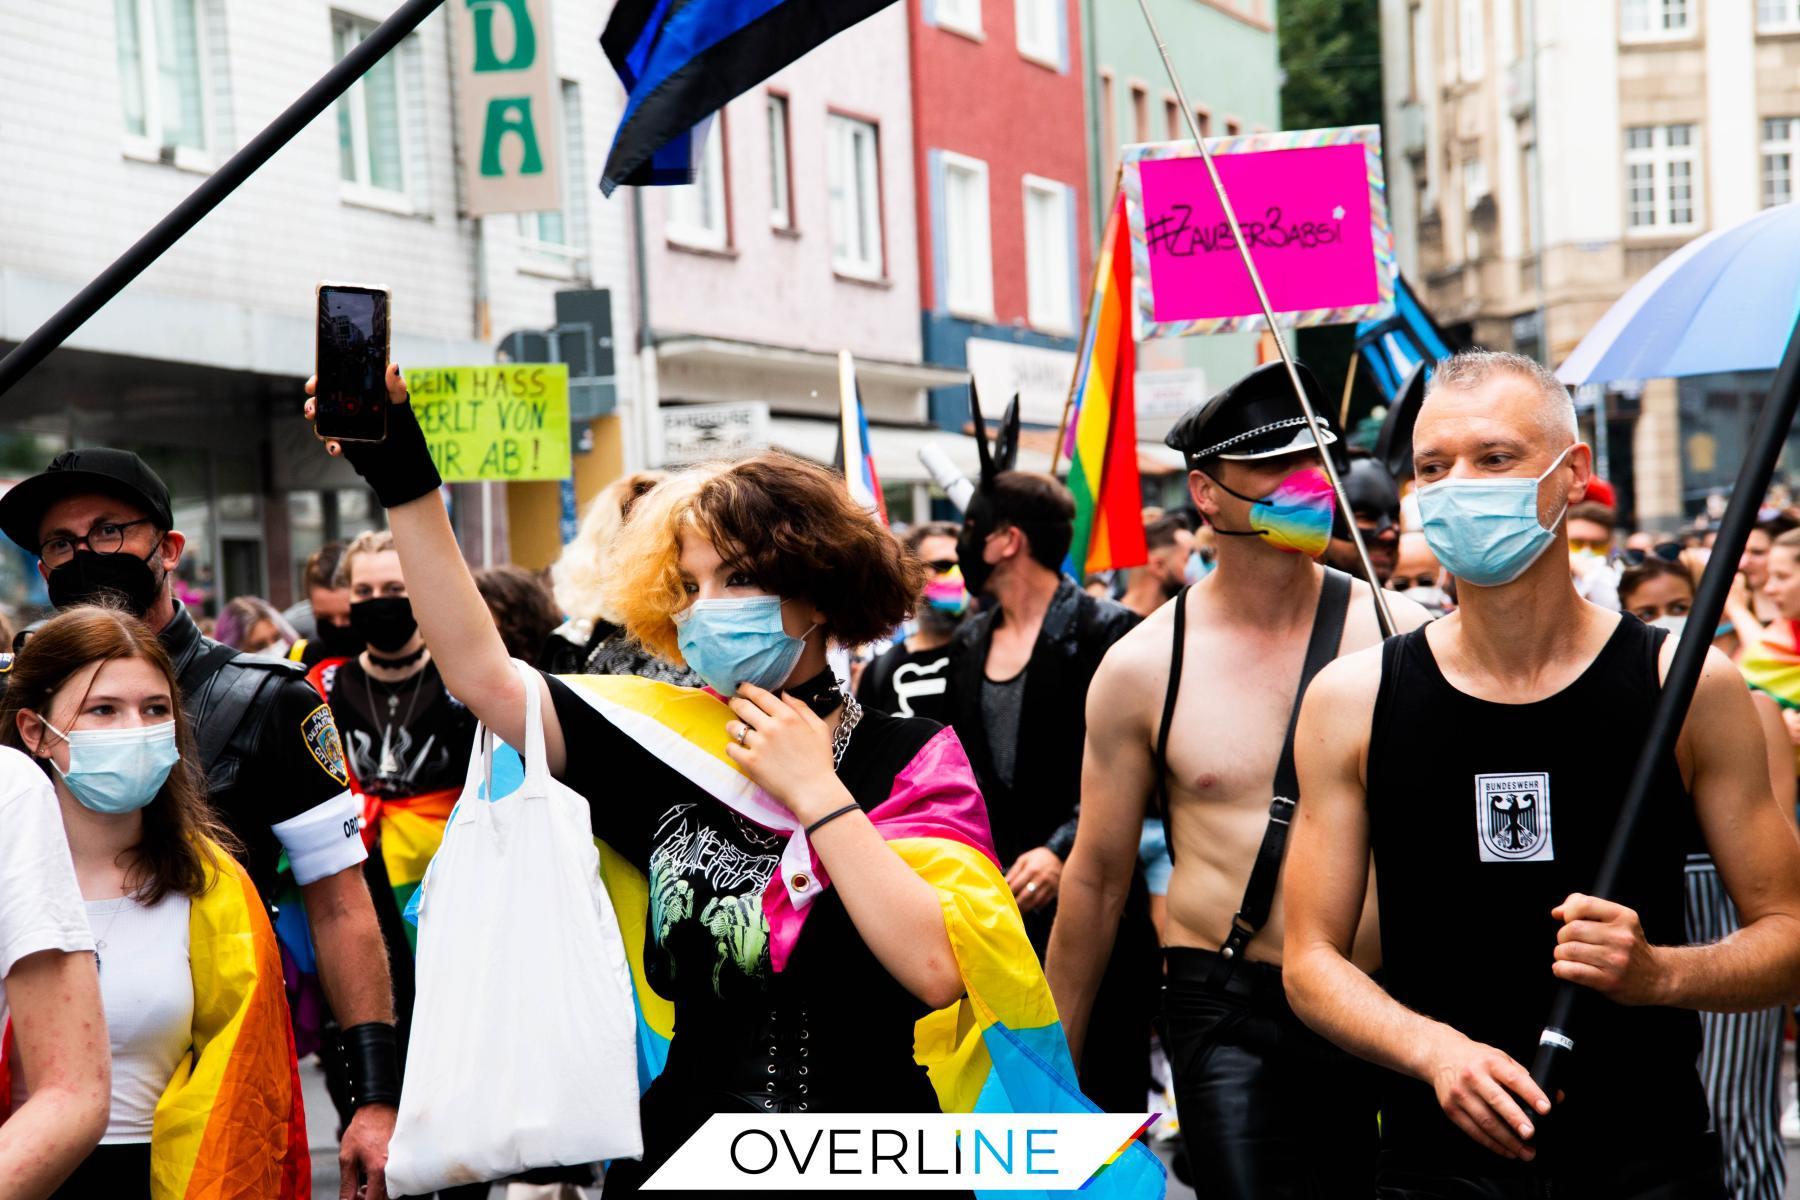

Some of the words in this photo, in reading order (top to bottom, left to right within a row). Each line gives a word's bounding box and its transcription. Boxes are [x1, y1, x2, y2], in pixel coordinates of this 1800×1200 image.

[410, 371, 458, 395] DEIN
[472, 368, 546, 398] HASS
[497, 400, 547, 432] VON
[314, 746, 329, 766] CITY
[1485, 780, 1539, 791] BUNDESWEHR
